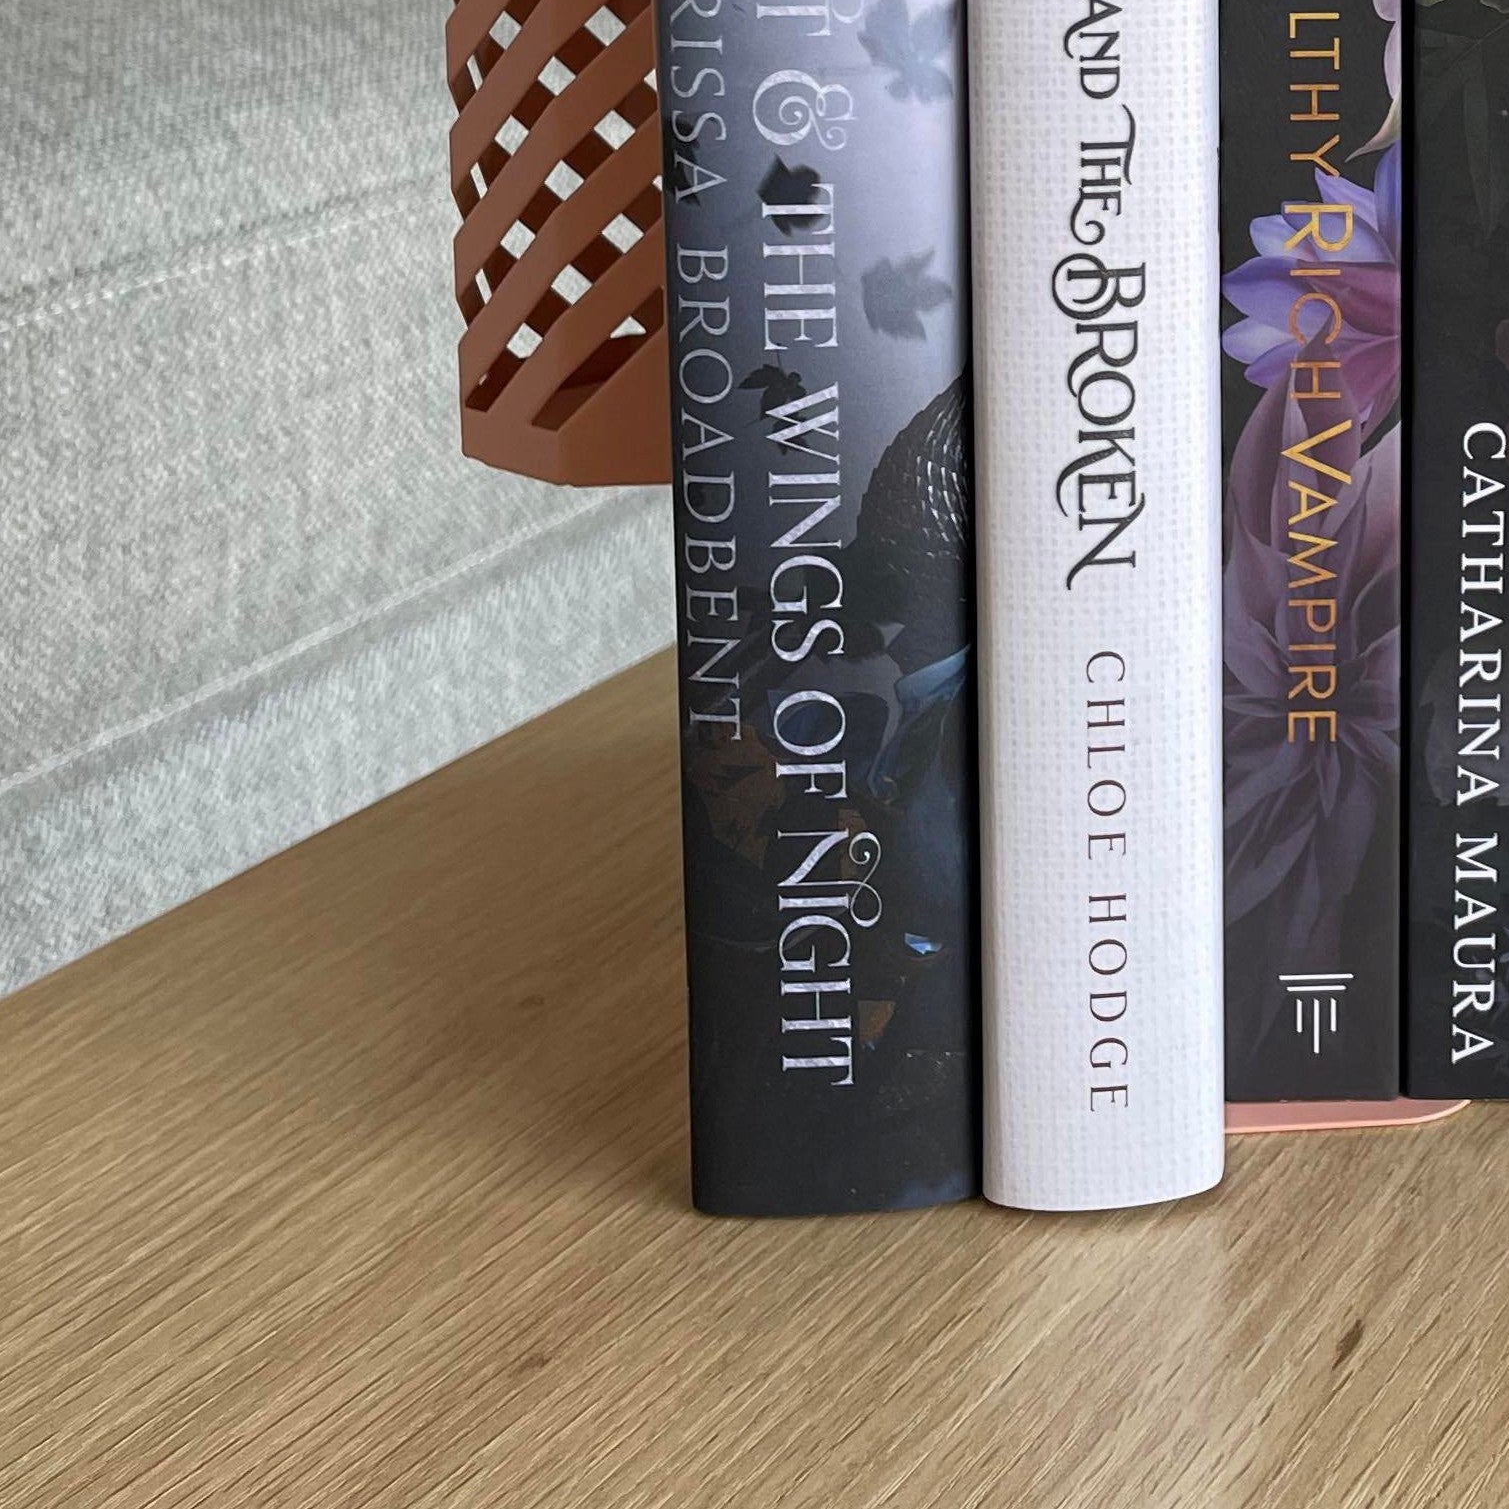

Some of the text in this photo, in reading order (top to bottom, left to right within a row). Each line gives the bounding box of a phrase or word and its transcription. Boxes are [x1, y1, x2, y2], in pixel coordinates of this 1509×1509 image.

[752, 69, 854, 151] &
[1069, 103, 1136, 246] THE
[761, 182, 840, 352] THE
[1285, 202, 1355, 401] RICH
[674, 242, 743, 742] BROADBENT
[764, 380, 846, 663] WINGS
[1051, 252, 1146, 591] BROKEN
[1282, 419, 1354, 744] VAMPIRE
[772, 689, 849, 799] OF
[1451, 422, 1508, 1066] CATHARINA MAURA
[775, 826, 882, 1086] NIGHT
[1085, 650, 1129, 1113] CHLOE HODGE
